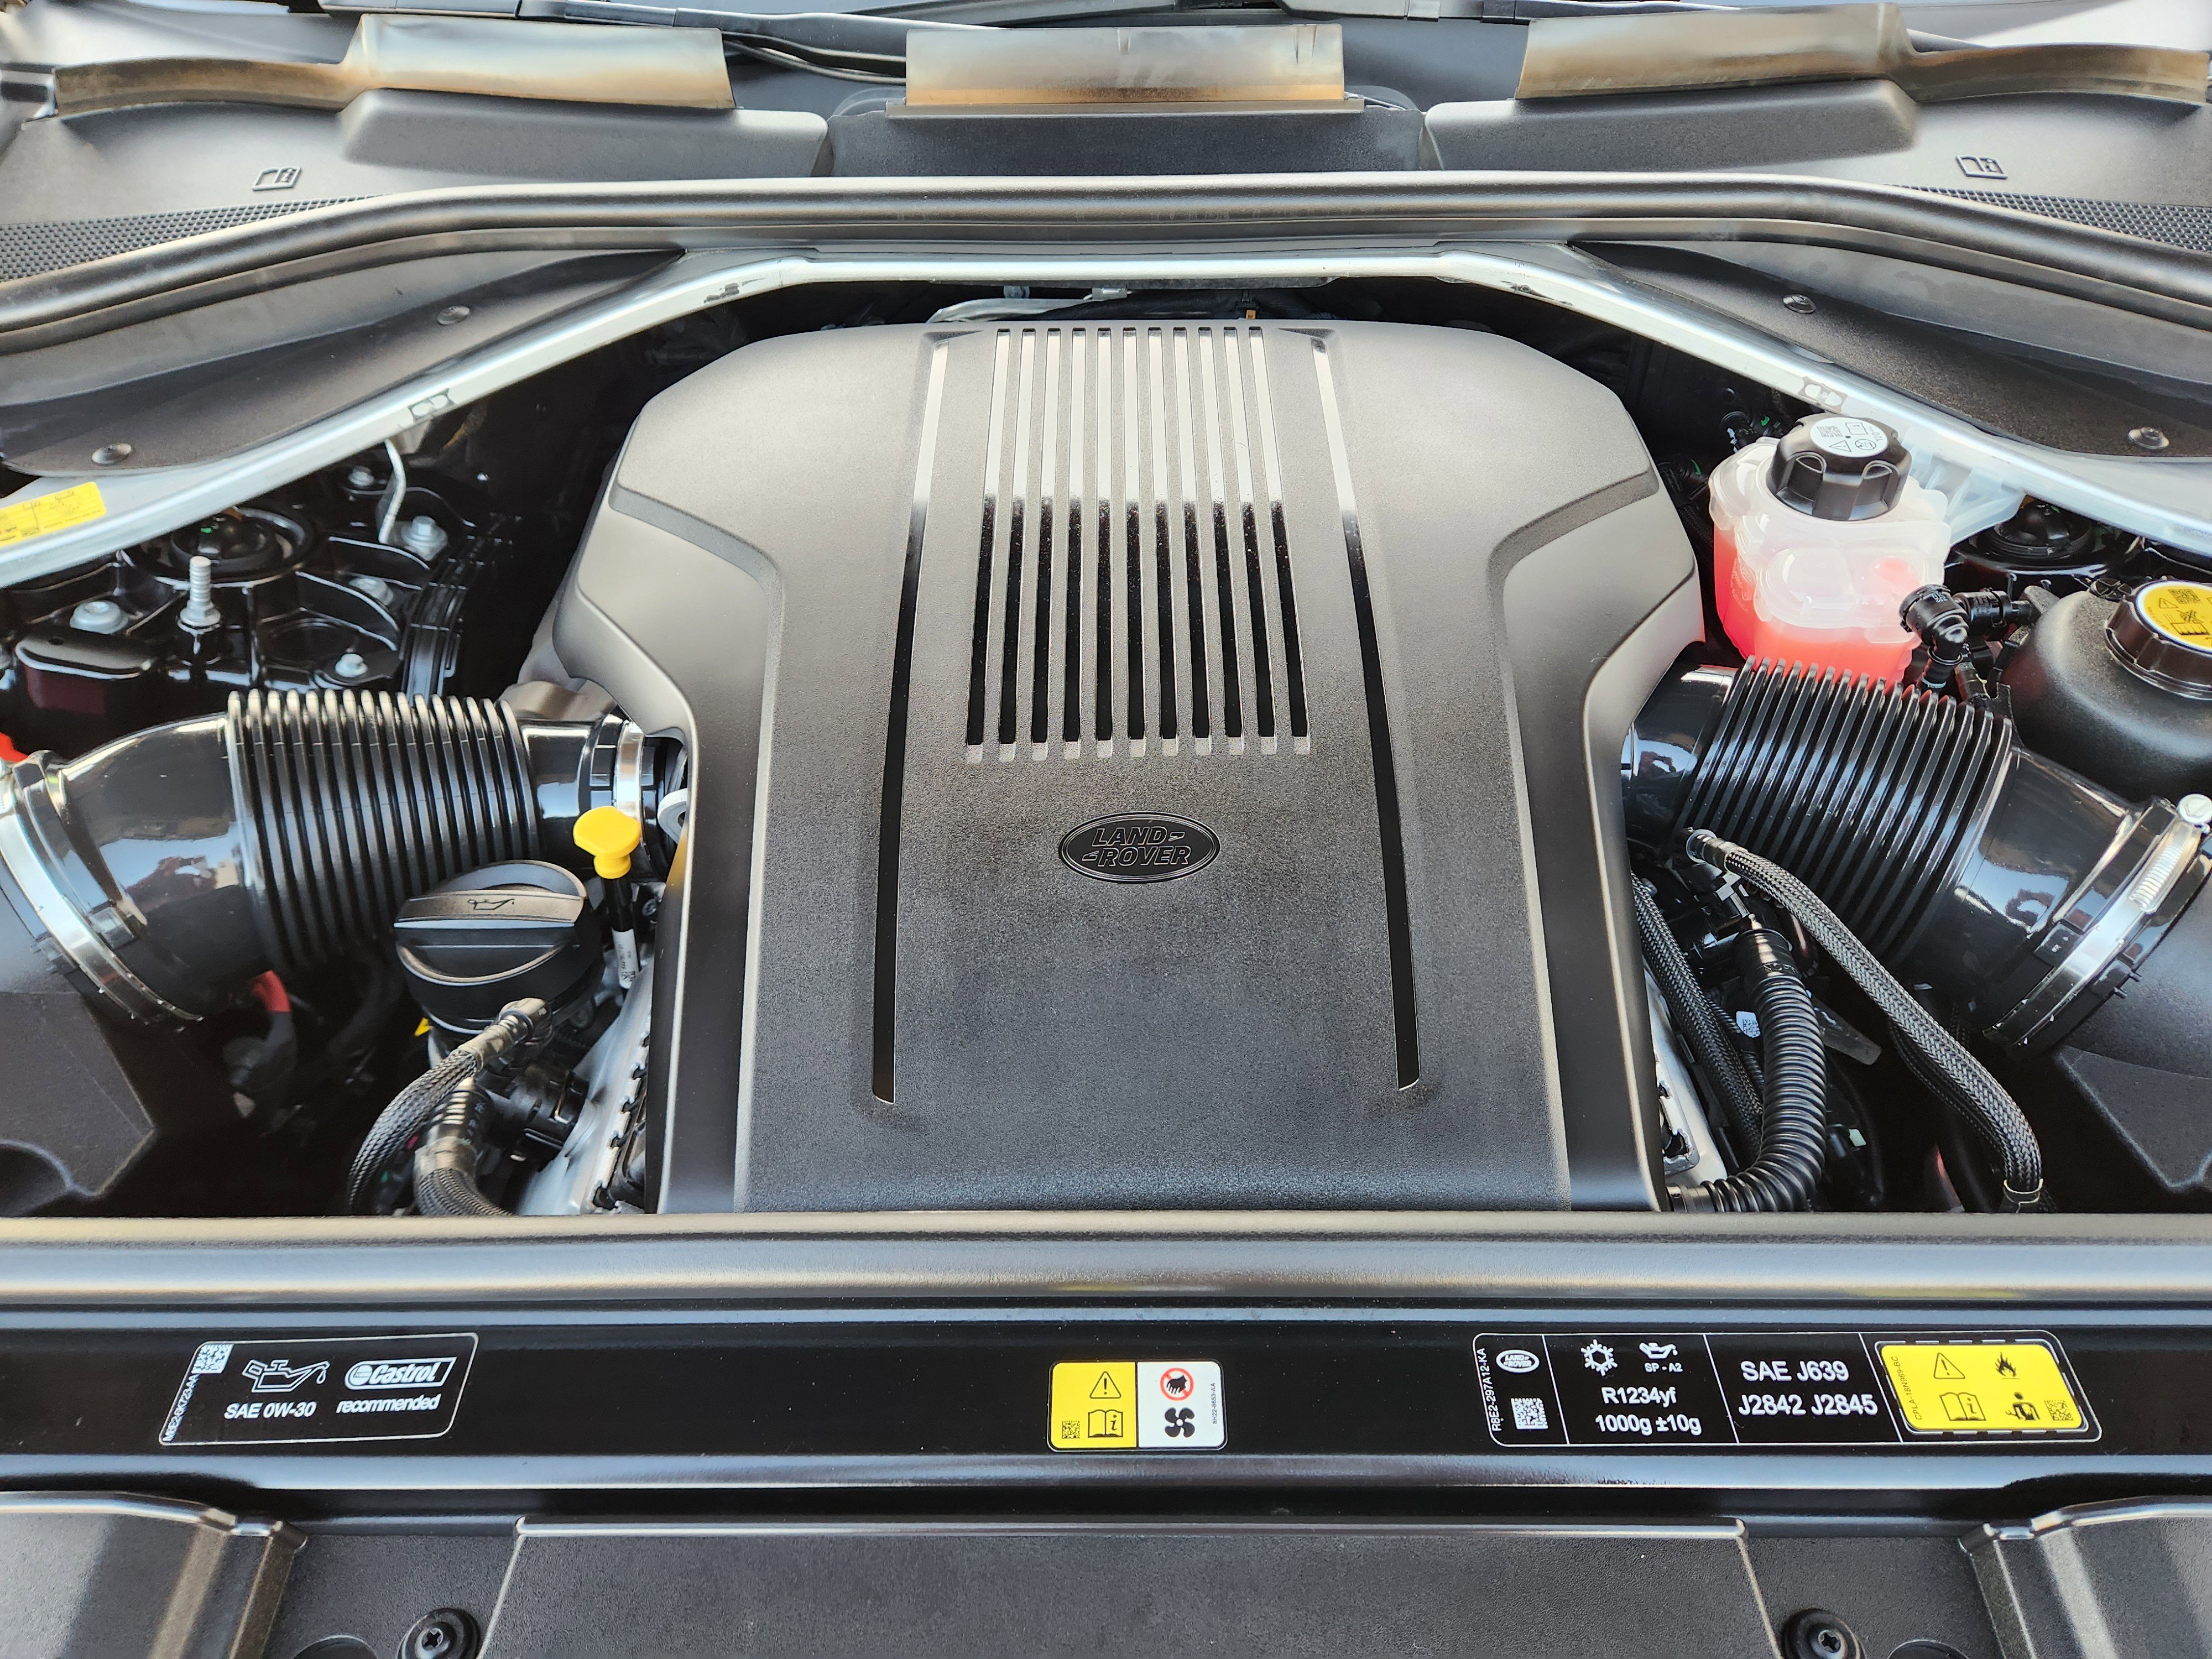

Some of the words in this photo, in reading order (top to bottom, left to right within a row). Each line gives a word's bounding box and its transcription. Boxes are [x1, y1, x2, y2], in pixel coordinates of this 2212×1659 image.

[1092, 826, 1167, 847] LAND
[1098, 846, 1191, 867] ROVER
[369, 1361, 441, 1385] Castrol
[1740, 1360, 1792, 1381] SAE
[1797, 1360, 1849, 1381] J639
[336, 1393, 442, 1413] recommended
[1601, 1386, 1677, 1407] R1234yf
[1738, 1394, 1807, 1415] J2842
[1811, 1394, 1878, 1415] J2845
[224, 1402, 263, 1419] SAE
[263, 1401, 317, 1418] 0W-30
[1595, 1414, 1653, 1436] 1000g
[1655, 1414, 1702, 1436] ±10g
